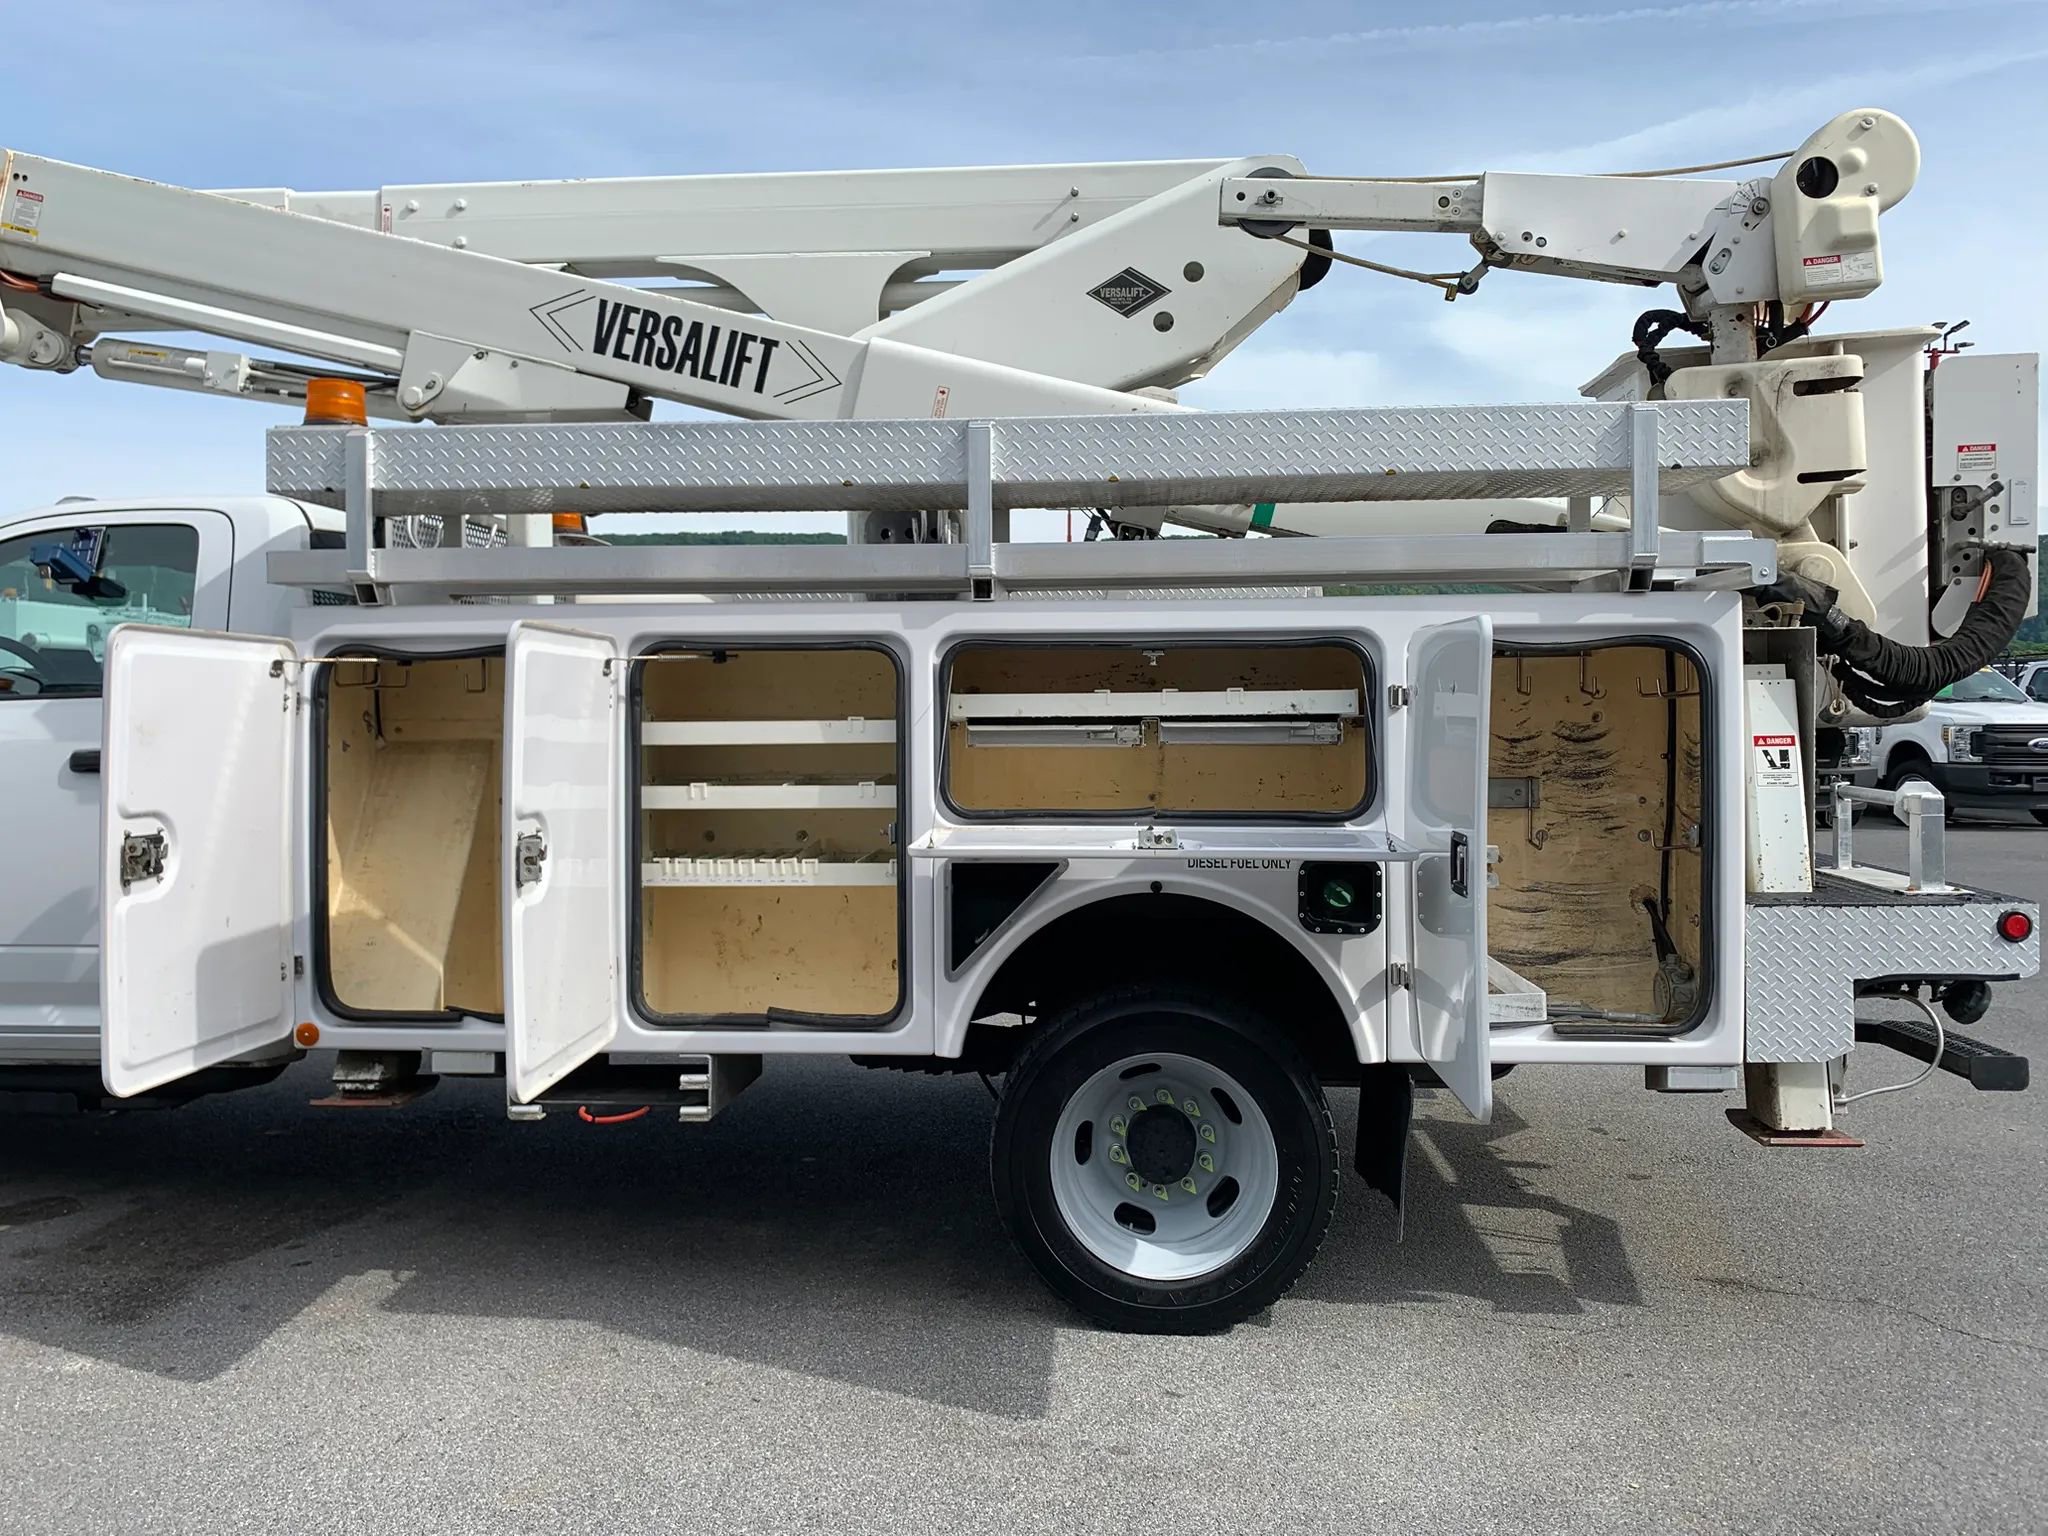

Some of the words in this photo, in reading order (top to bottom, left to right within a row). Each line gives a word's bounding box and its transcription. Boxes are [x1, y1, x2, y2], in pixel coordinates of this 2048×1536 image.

[1812, 256, 1839, 265] DANGER
[1100, 287, 1145, 298] VERSALIFT
[593, 298, 780, 394] VERSALIFT
[1766, 737, 1792, 745] DANGER
[1187, 858, 1228, 869] DIESEL
[1230, 858, 1260, 869] FUEL
[1261, 859, 1292, 869] ONLY
